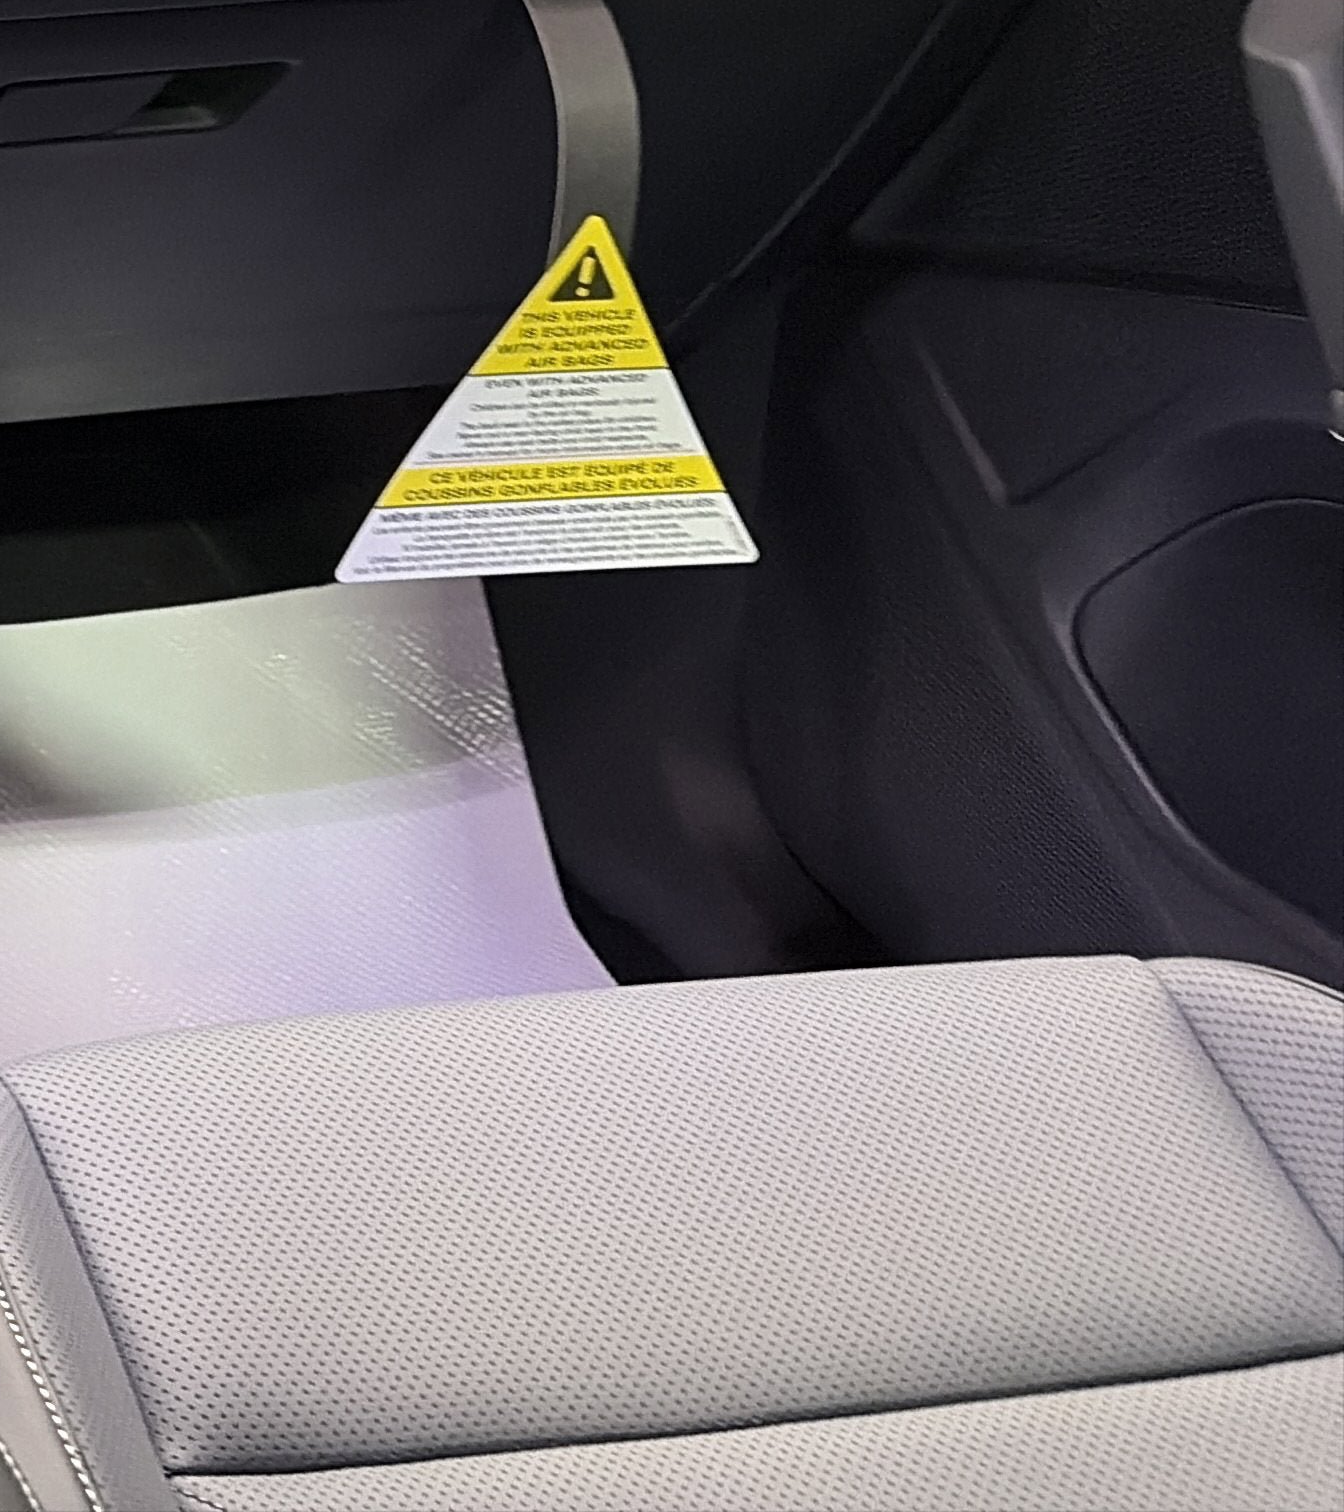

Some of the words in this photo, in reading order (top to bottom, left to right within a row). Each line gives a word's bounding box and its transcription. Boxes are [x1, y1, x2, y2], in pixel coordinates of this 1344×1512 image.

[564, 308, 636, 322] VEHICLE
[541, 324, 632, 338] EQUIPPED
[549, 338, 650, 353] ADVANCED
[525, 356, 558, 368] AIR
[562, 354, 615, 367] BAGS
[650, 461, 677, 475] DE
[402, 484, 496, 502] COUSSINS
[497, 479, 616, 498] GONFLABLES
